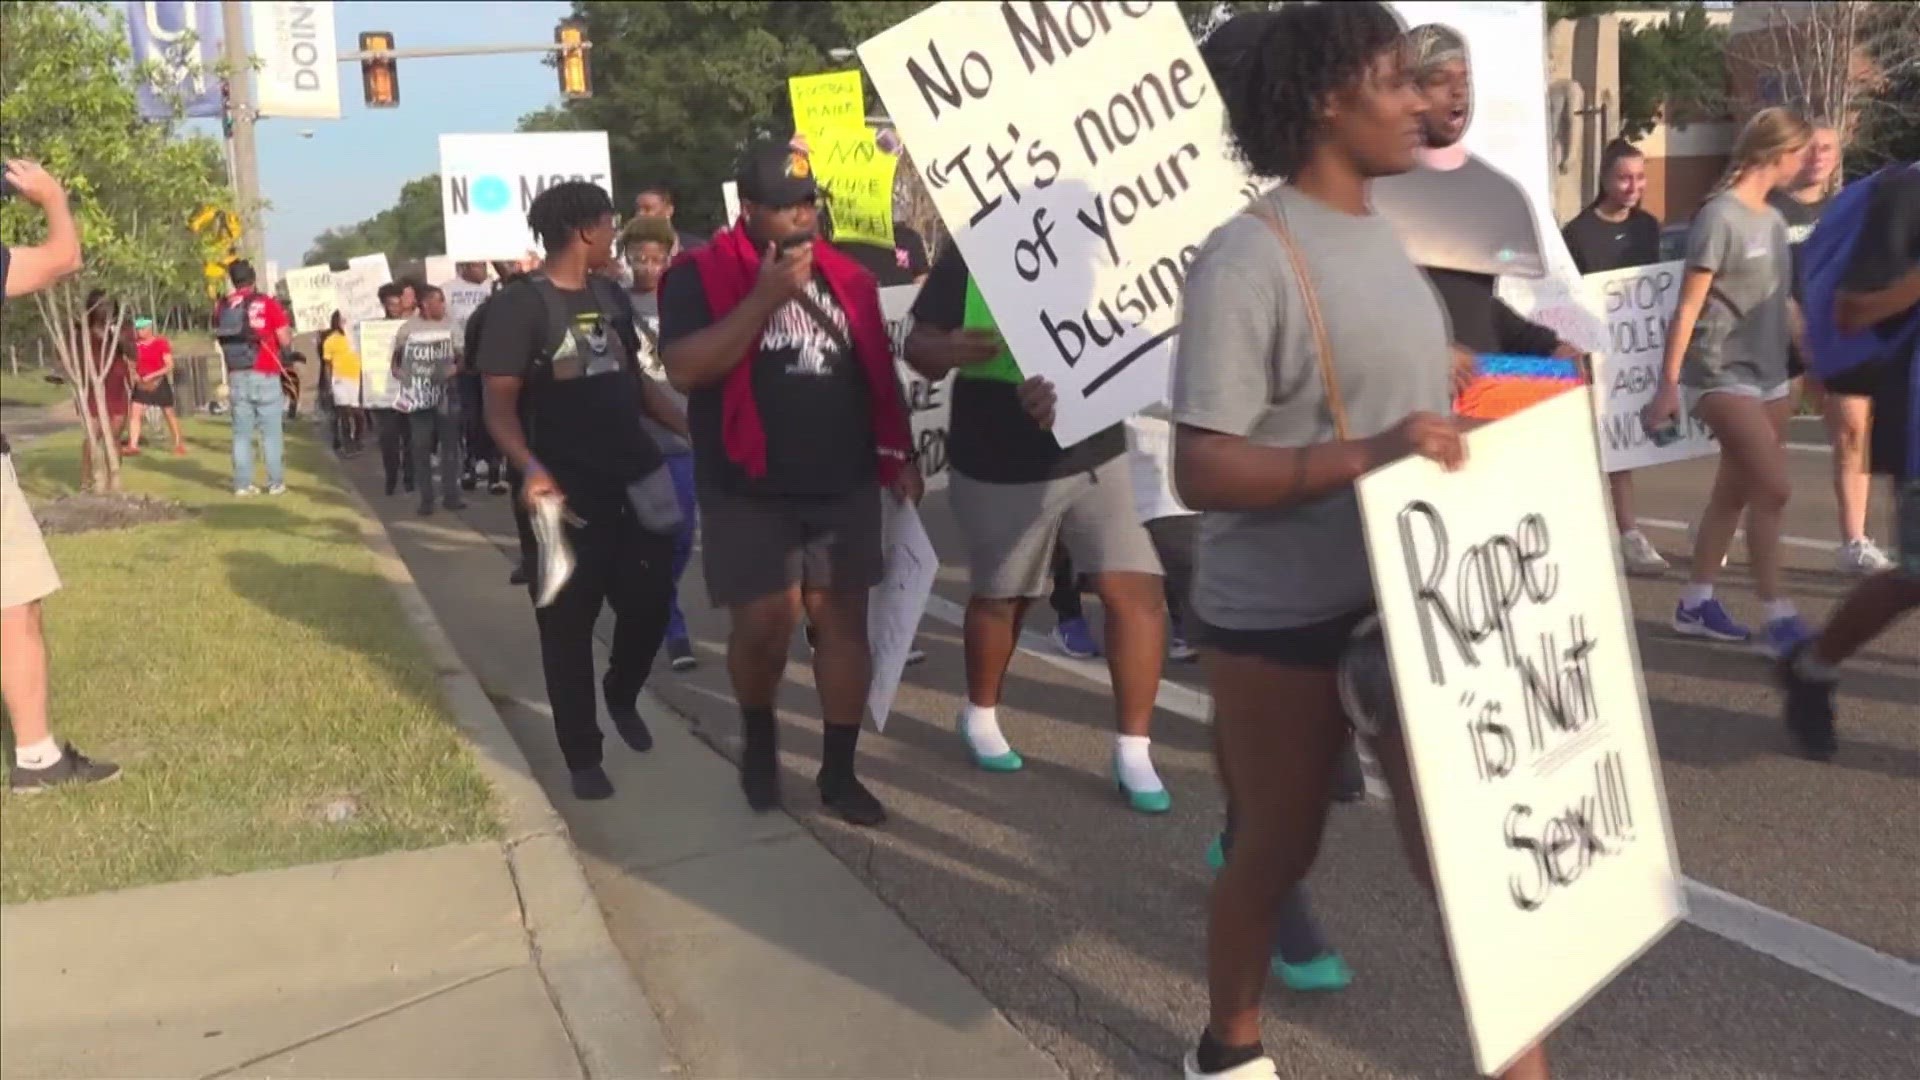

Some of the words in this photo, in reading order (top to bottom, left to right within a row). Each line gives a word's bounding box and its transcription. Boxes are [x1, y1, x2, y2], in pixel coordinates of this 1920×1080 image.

[289, 4, 320, 91] DOIN
[905, 38, 994, 120] No
[1073, 57, 1208, 167] none
[1014, 206, 1060, 283] of
[1076, 142, 1200, 268] your
[1605, 271, 1674, 312] STOP
[1397, 500, 1559, 685] Rape
[1459, 690, 1517, 784] is
[1517, 614, 1600, 752] Not
